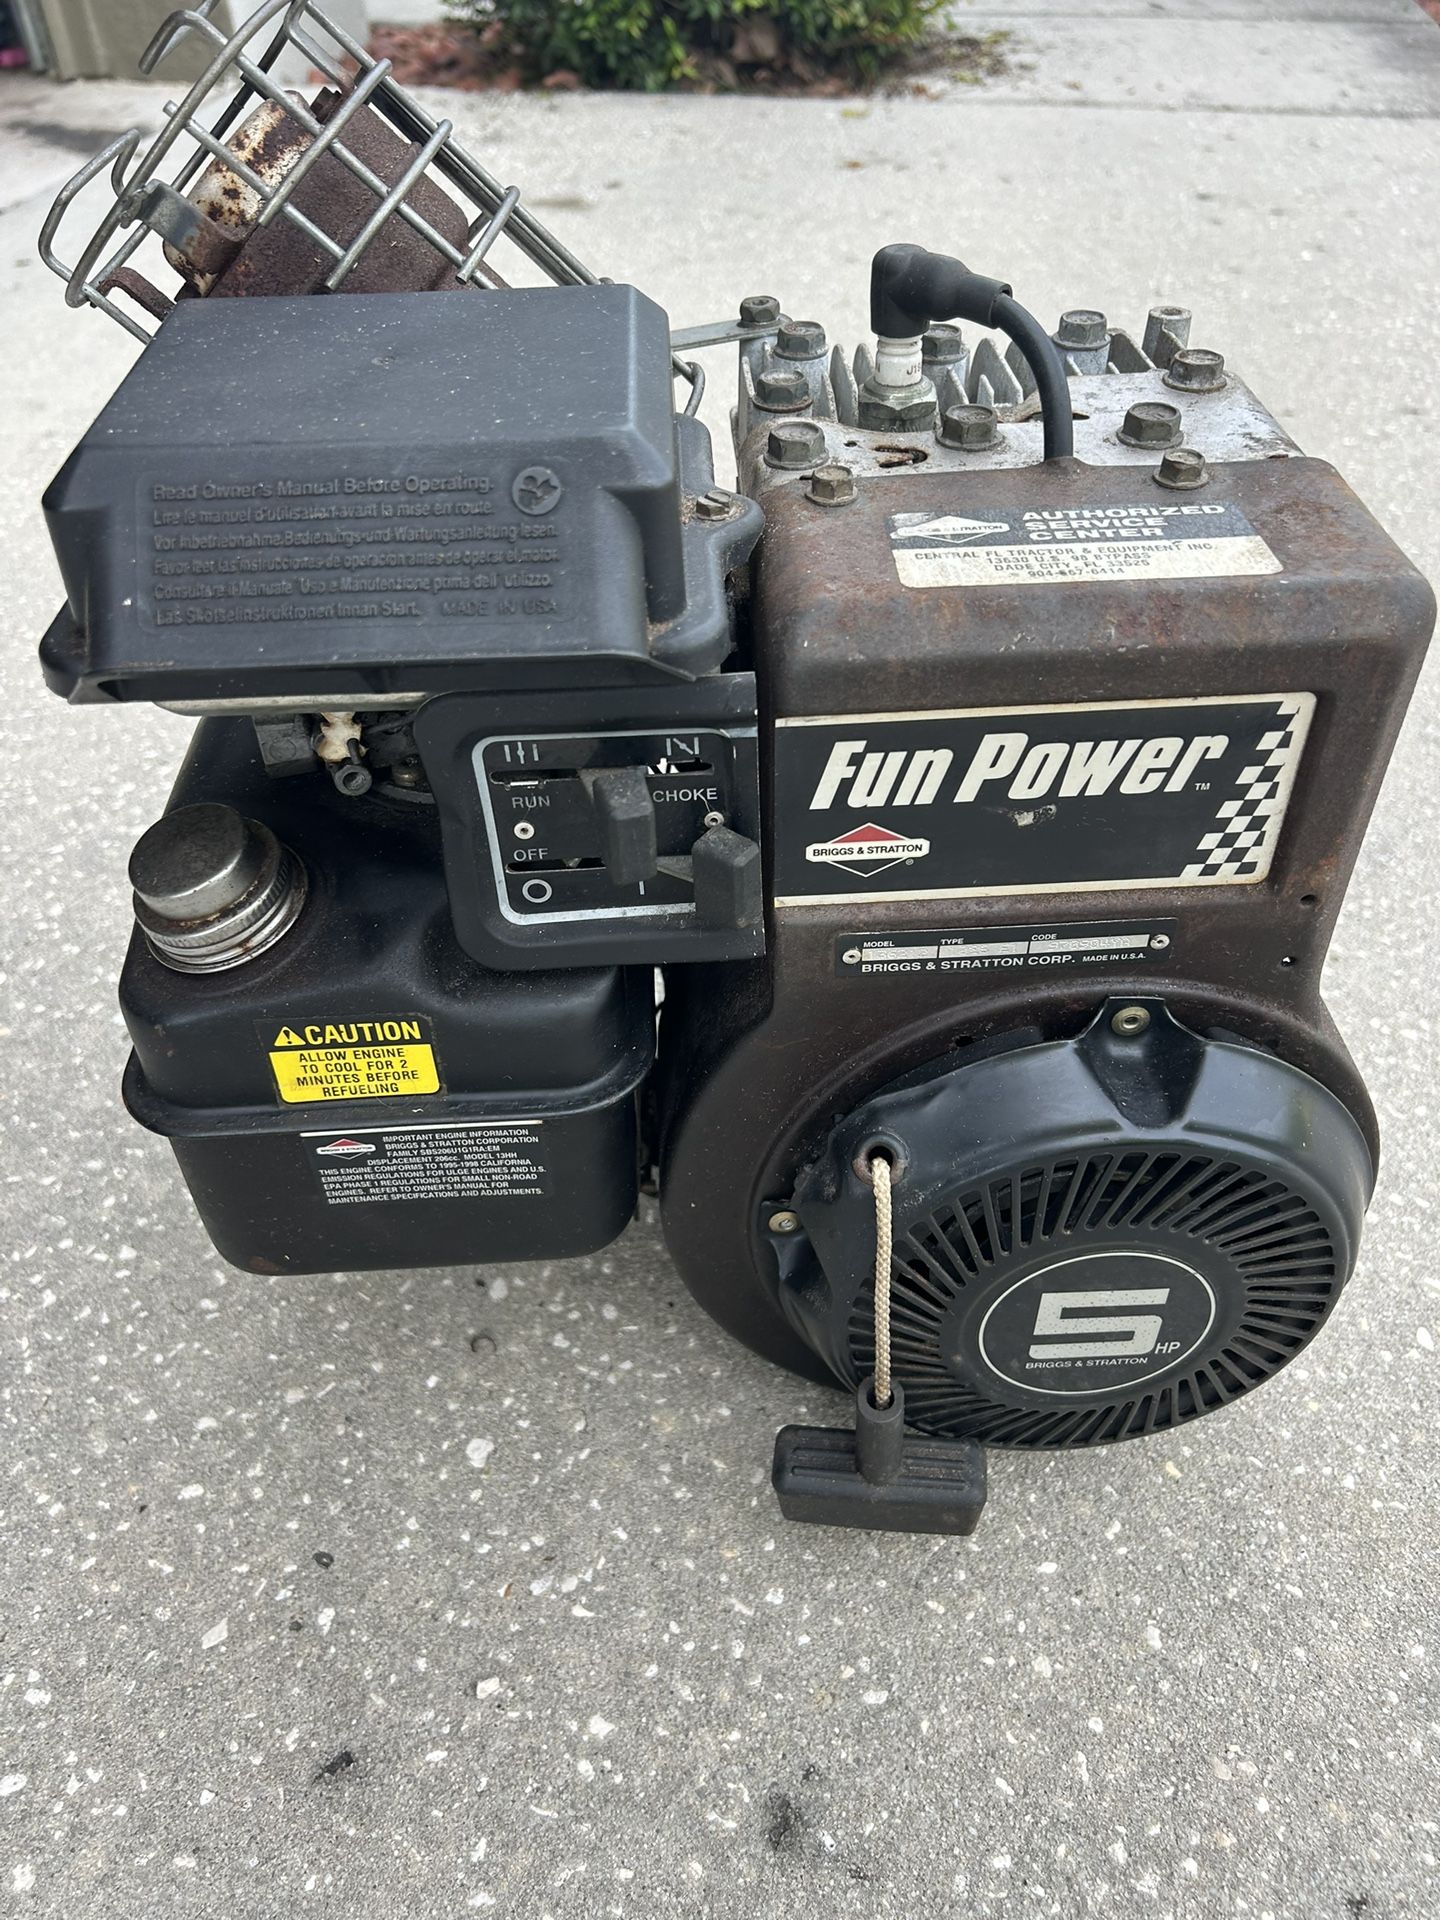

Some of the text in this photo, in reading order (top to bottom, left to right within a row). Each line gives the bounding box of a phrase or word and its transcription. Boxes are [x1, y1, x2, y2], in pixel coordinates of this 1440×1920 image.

[154, 475, 495, 500] Read Owner's Manual Before Operating.
[200, 507, 251, 524] manuel
[381, 502, 393, 518] la
[398, 502, 431, 517] mise
[1022, 504, 1226, 521] AUTHORIZED
[1024, 517, 1168, 530] SERVICE
[1029, 527, 1164, 540] CENTER
[154, 535, 176, 551] Vor
[914, 551, 979, 560] CENTRAL
[1007, 548, 1074, 557] TRACTOR
[1082, 547, 1092, 555] &
[1096, 543, 1182, 554] EQUIPMENT
[1094, 552, 1152, 560] BYPASS
[994, 563, 1035, 571] DADE
[442, 599, 558, 616] MADE IN USA
[808, 740, 954, 810] Fun
[953, 733, 1230, 803] Power
[512, 795, 550, 809] RUN
[652, 787, 718, 803] CHOKE
[513, 848, 549, 861] OFF
[812, 844, 922, 857] BRIGGS & STRATTON
[1031, 933, 1057, 941] CODE
[861, 952, 1146, 973] BRIGGS & STRATTON CORP. MADE IN U.S.A.
[304, 1021, 422, 1045] CAUTION
[299, 1048, 405, 1063] ALLOW ENGINE
[301, 1059, 408, 1074] TO COOL FOR 2
[296, 1070, 419, 1087] MINUTES BEFORE
[323, 1083, 399, 1097] REFUELING
[382, 1129, 529, 1143] IMPORTANT ENGINE INFORMATION
[385, 1142, 418, 1150] BRIGGS
[428, 1139, 474, 1147] STRATTON
[476, 1136, 539, 1145] CORPORATION
[367, 1156, 433, 1166] DISPLACEMENT
[464, 1153, 494, 1161] MODEL
[387, 1149, 419, 1157] FAMILY
[321, 1174, 362, 1183] EMISSION
[364, 1171, 425, 1180] REGULATIONS
[446, 1168, 469, 1176] ULGE
[471, 1166, 508, 1175] ENGINES
[510, 1165, 528, 1173] AND
[340, 1166, 373, 1175] ENGINE
[374, 1163, 424, 1172] CONFORMS
[440, 1161, 479, 1169] 1995-1998
[480, 1159, 532, 1167] CALIFORNIA
[343, 1181, 373, 1189] PHASE
[380, 1177, 440, 1186] REGULATIONS
[462, 1174, 491, 1182] SMALL
[492, 1173, 537, 1181] NON-ROAD
[326, 1189, 366, 1198] ENGINES.
[369, 1186, 398, 1195] REFER
[413, 1183, 452, 1192] OWNER'S
[454, 1181, 490, 1190] MANUAL
[327, 1188, 544, 1204] MAINTENANCE SPECIFICATIONS AND ADJUSTMENTS.
[1029, 1288, 1180, 1359] 5 HP
[1025, 1361, 1071, 1369] BRIGGS
[1086, 1357, 1148, 1366] STRATTON
